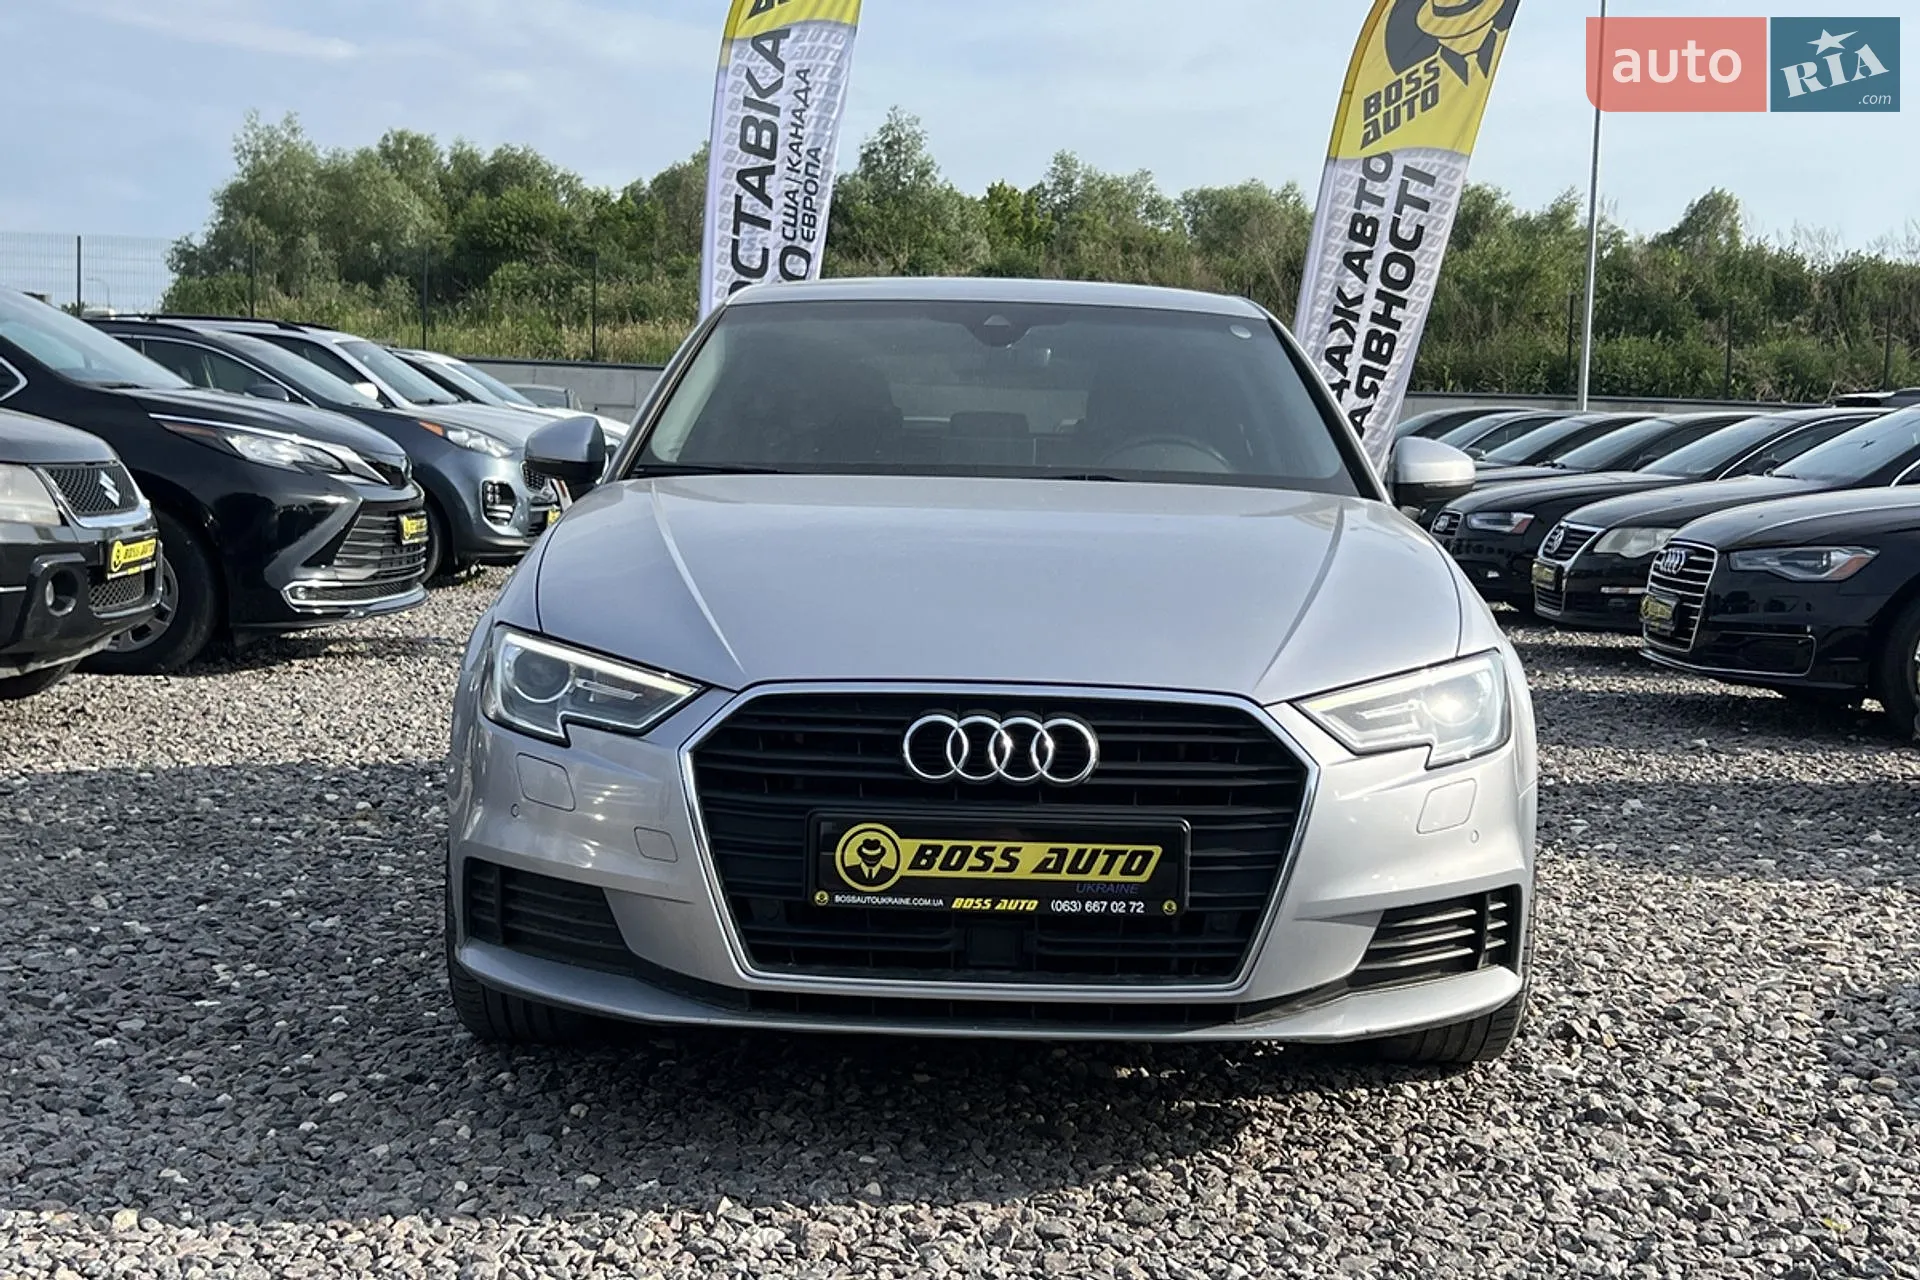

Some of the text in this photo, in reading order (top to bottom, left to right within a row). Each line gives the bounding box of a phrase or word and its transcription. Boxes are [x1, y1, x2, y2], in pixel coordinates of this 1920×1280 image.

[786, 68, 811, 174] КАНАДА
[1360, 82, 1440, 150] AUTO
[1363, 56, 1441, 122] BOSS
[728, 28, 792, 295] СТАВКА
[801, 147, 822, 243] ЕВРОПА
[782, 187, 801, 242] США
[1343, 151, 1394, 284] АВТО
[907, 844, 1156, 877] BOSS AUTO
[1076, 883, 1140, 895] UKRAINE
[834, 895, 1145, 914] BOSSAUTOUKRAINE.COM.UA BOSS AUTO (063) 667 02 72
